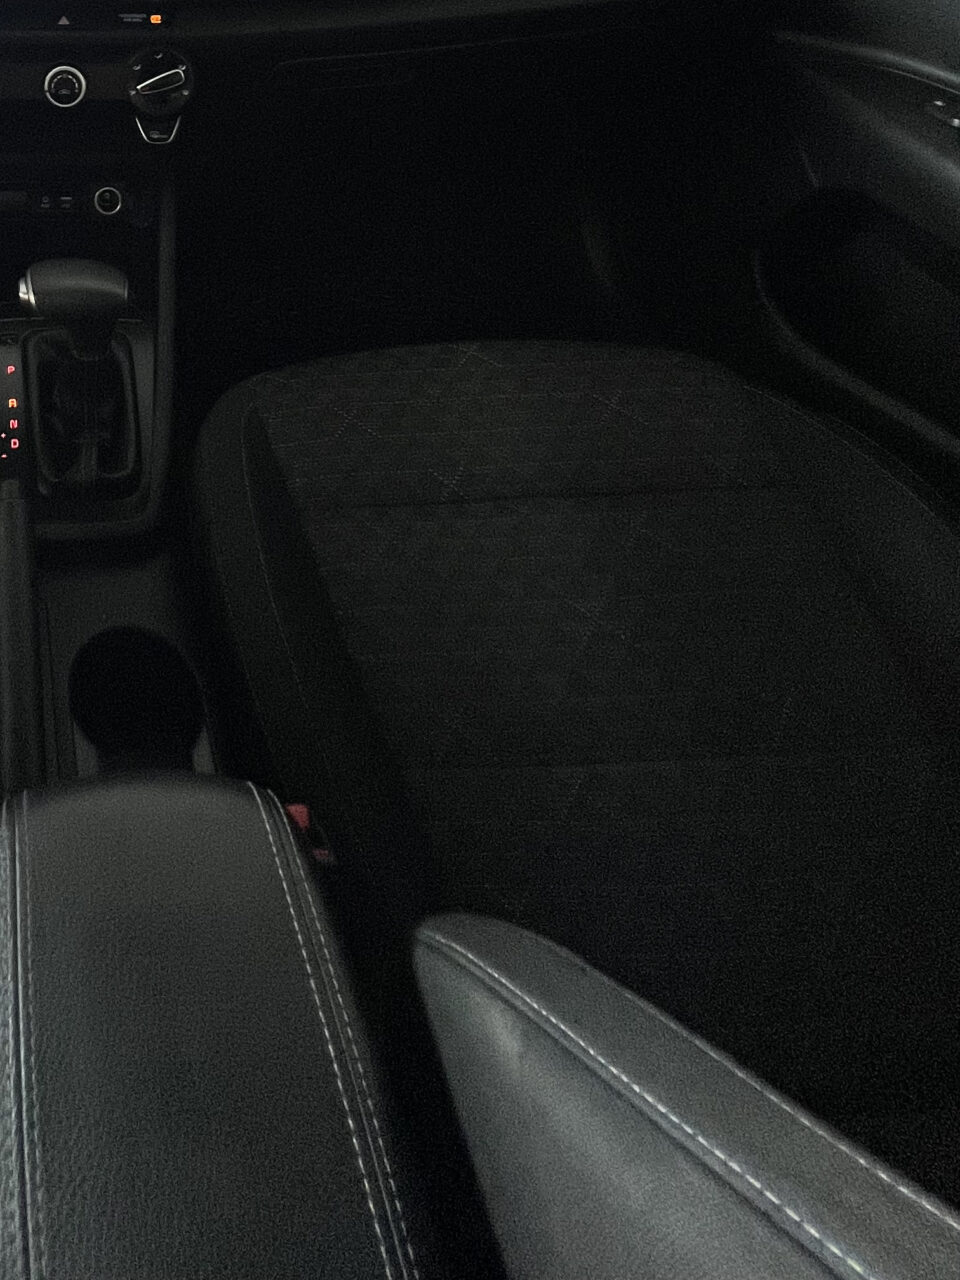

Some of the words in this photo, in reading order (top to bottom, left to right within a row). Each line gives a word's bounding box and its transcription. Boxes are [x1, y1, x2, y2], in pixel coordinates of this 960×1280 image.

[7, 365, 16, 375] P
[10, 419, 18, 429] N
[10, 438, 19, 449] D
